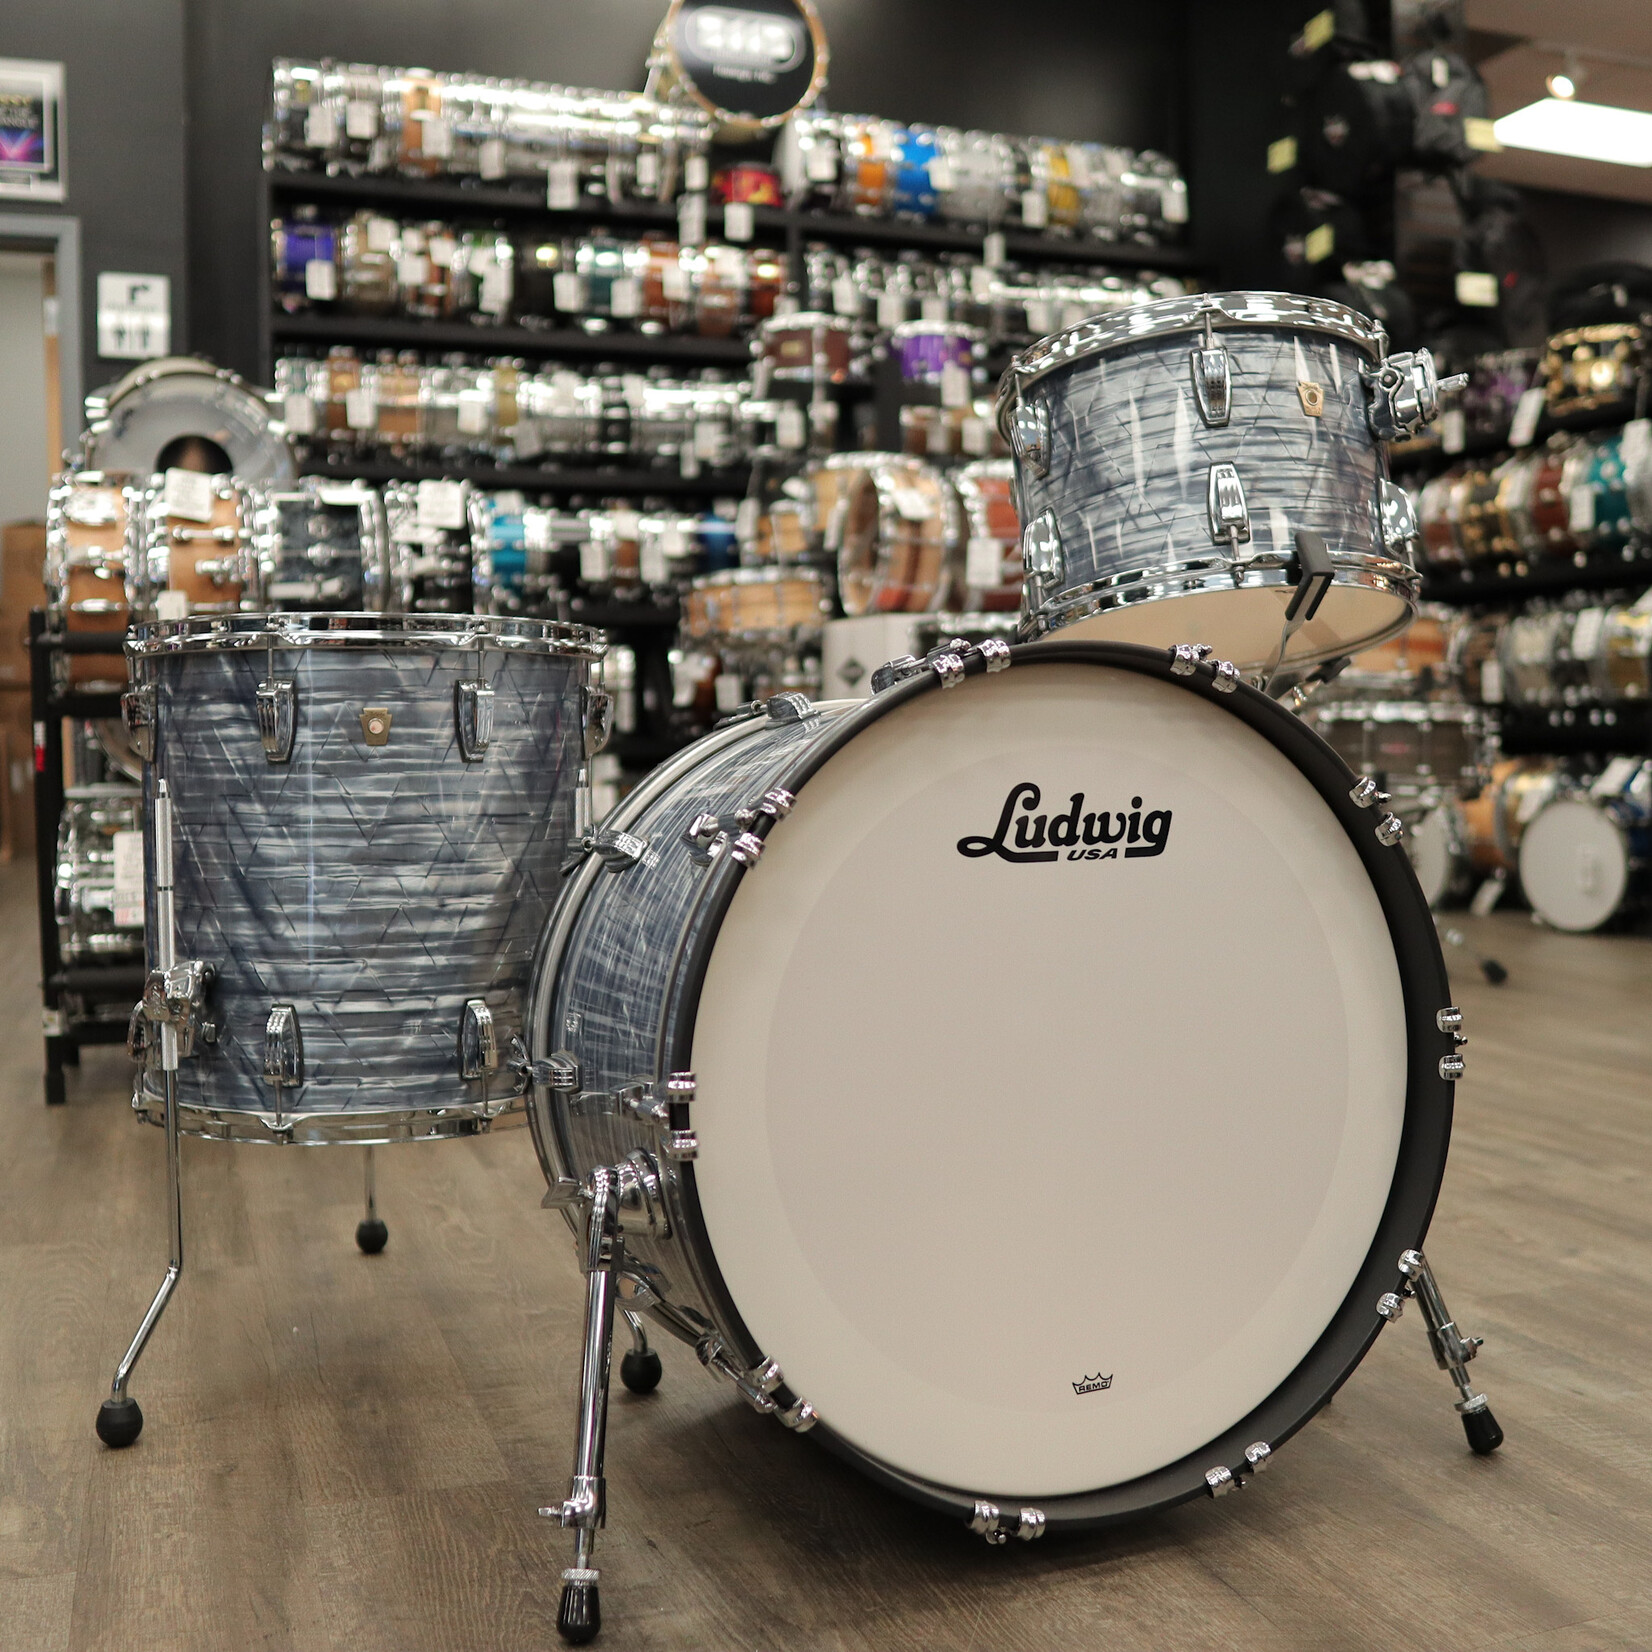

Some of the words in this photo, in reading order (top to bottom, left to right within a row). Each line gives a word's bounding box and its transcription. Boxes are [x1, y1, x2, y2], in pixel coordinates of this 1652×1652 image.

[957, 782, 1172, 863] Ludwig
[1067, 848, 1118, 861] USA
[1078, 1381, 1108, 1391] REMO
